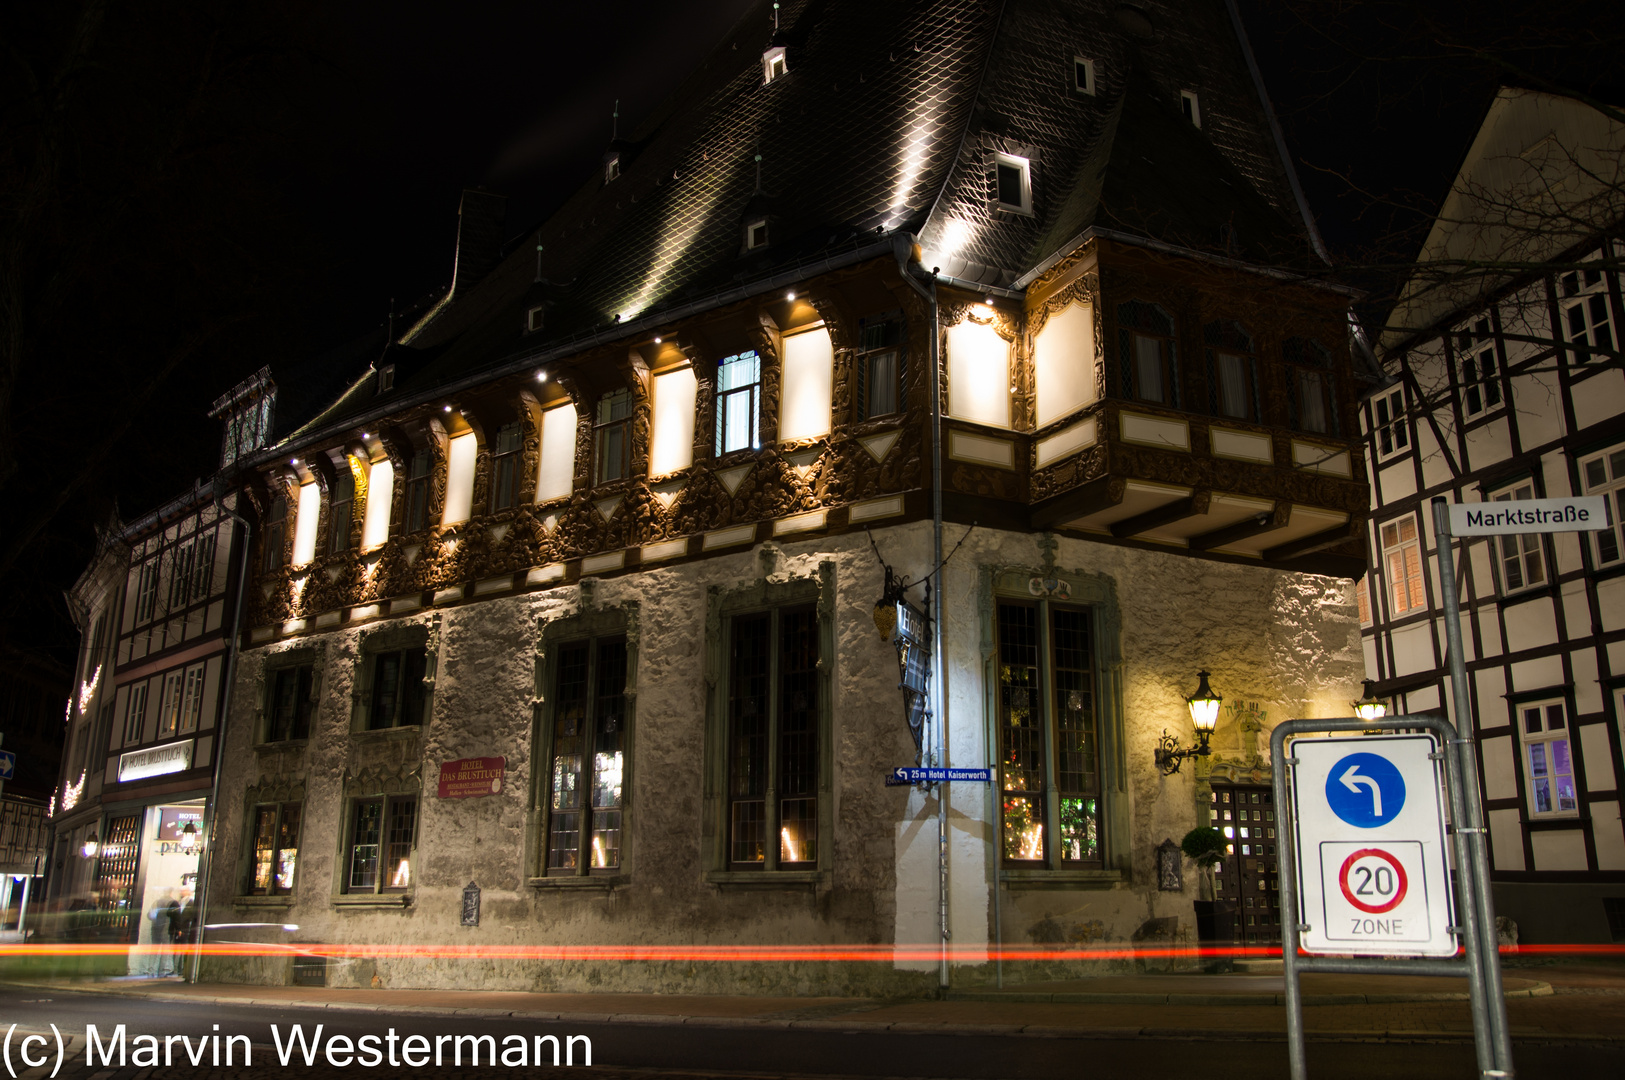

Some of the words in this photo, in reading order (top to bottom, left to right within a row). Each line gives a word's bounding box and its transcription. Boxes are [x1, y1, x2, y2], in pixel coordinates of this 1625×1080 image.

[1466, 505, 1590, 528] Marktstraße
[902, 607, 924, 642] Hotel
[129, 754, 146, 768] HOTEL
[147, 747, 181, 765] BRUSTTUCH
[461, 760, 483, 769] HOTEL
[442, 772, 456, 782] DAS
[457, 768, 502, 781] BRUSTTUCH
[928, 770, 946, 779] Hotel
[948, 770, 987, 779] Kaiserworth
[1354, 866, 1395, 896] 20
[1351, 918, 1404, 936] ZONE
